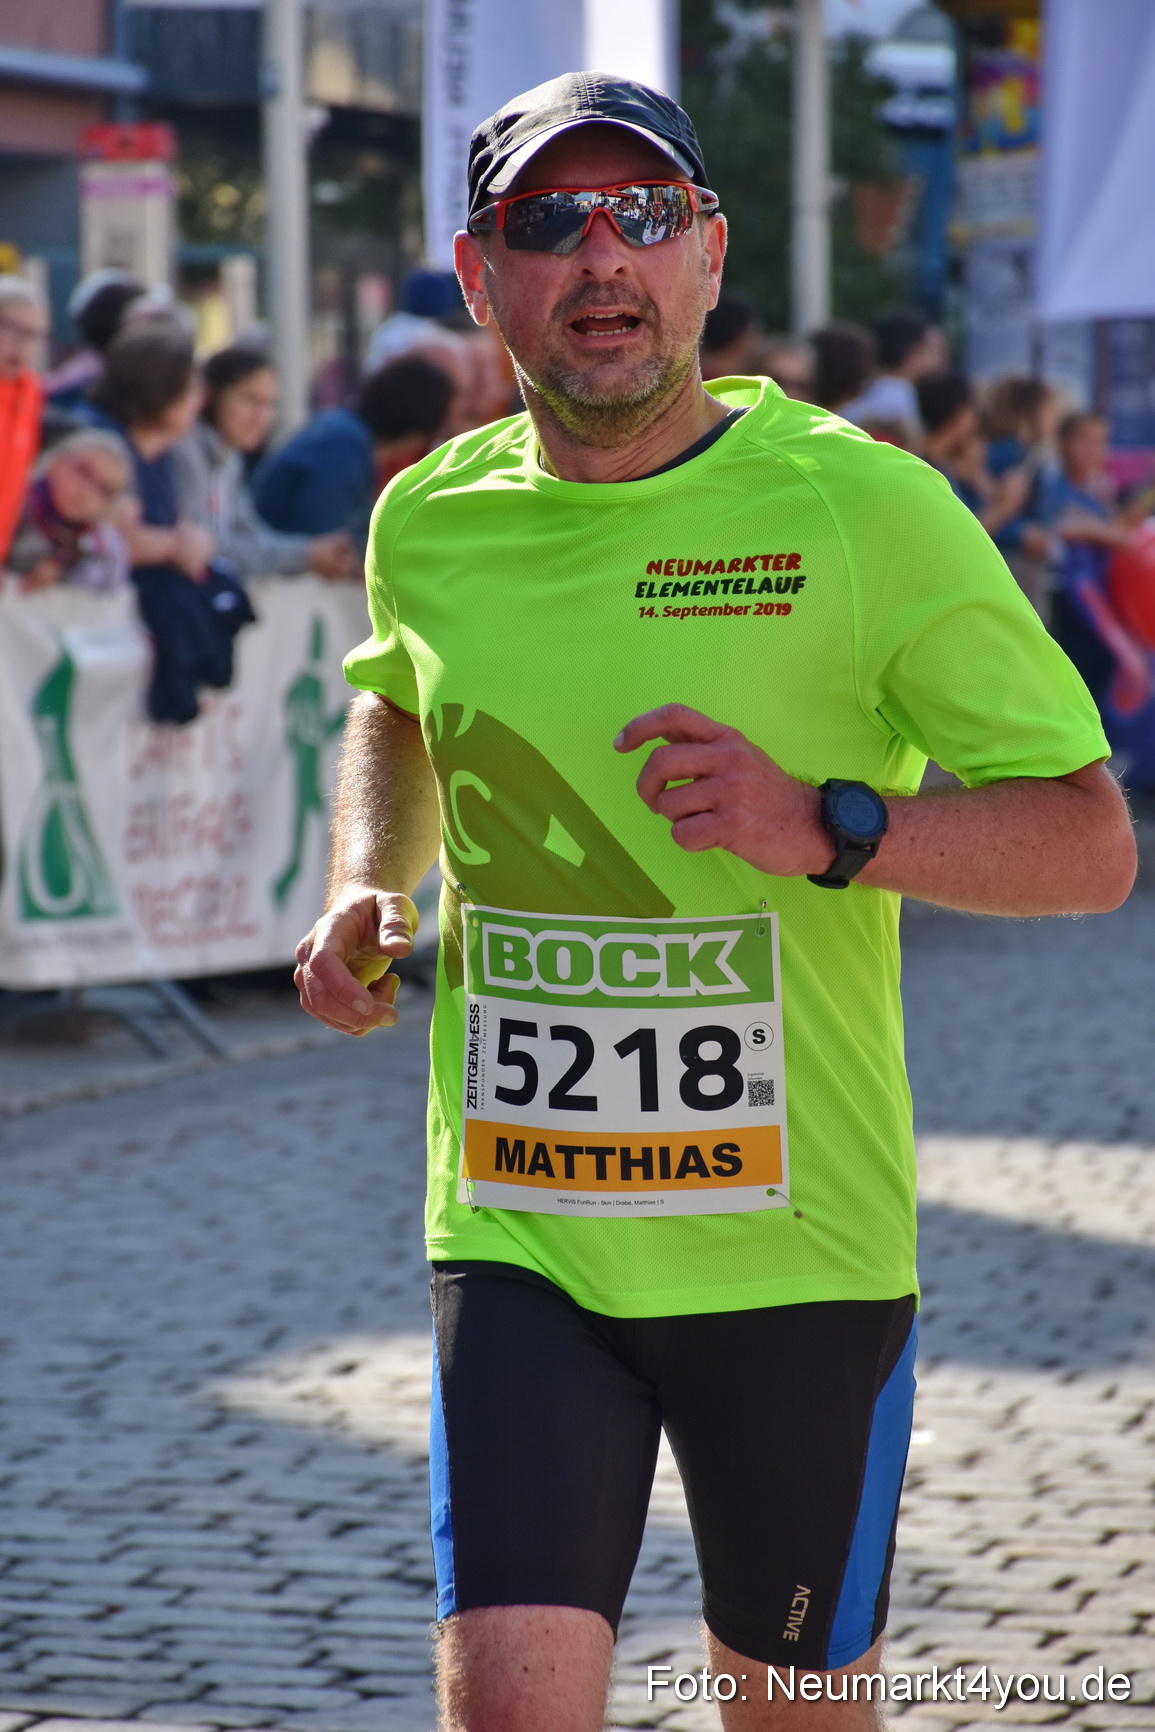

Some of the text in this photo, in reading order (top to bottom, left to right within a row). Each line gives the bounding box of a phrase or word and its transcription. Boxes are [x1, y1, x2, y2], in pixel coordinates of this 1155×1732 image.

[645, 552, 802, 577] NEUMARKTER
[634, 575, 807, 598] ELEMENTELAUF
[638, 602, 793, 620] 14. September 2019
[482, 922, 751, 997] BOCK
[752, 1028, 766, 1044] S
[494, 1018, 744, 1112] 5218
[494, 1136, 743, 1181] MATTHIAS
[783, 1584, 811, 1641] ACTIVE
